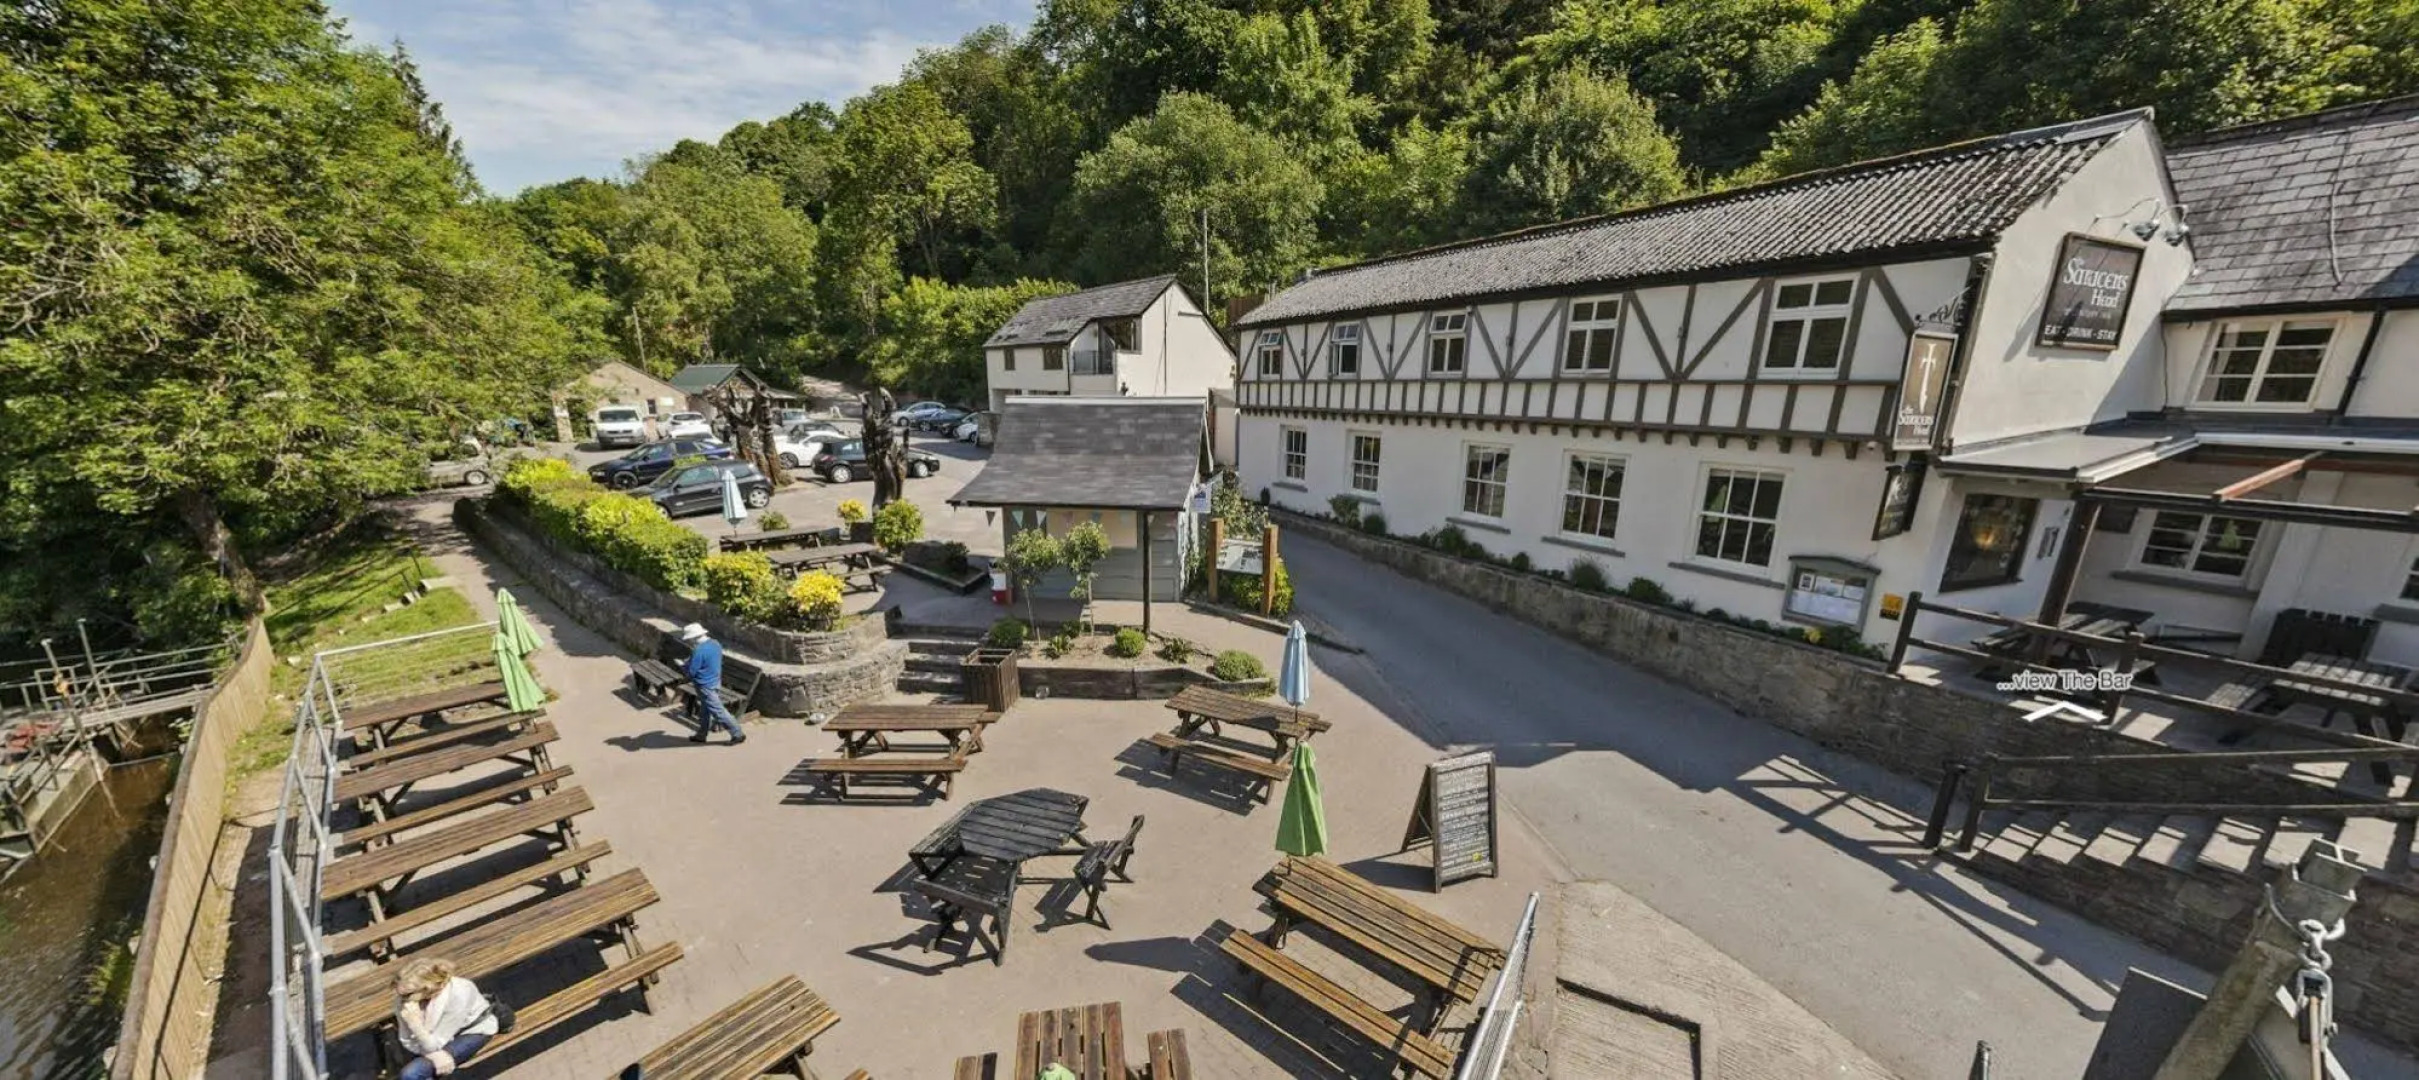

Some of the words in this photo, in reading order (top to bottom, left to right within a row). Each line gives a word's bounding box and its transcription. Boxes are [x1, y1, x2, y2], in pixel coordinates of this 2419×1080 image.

[2063, 257, 2129, 290] Saracens
[2091, 289, 2121, 308] Head
[2044, 325, 2062, 335] EAT
[2066, 327, 2093, 338] DRINK
[2096, 330, 2118, 341] STAY
